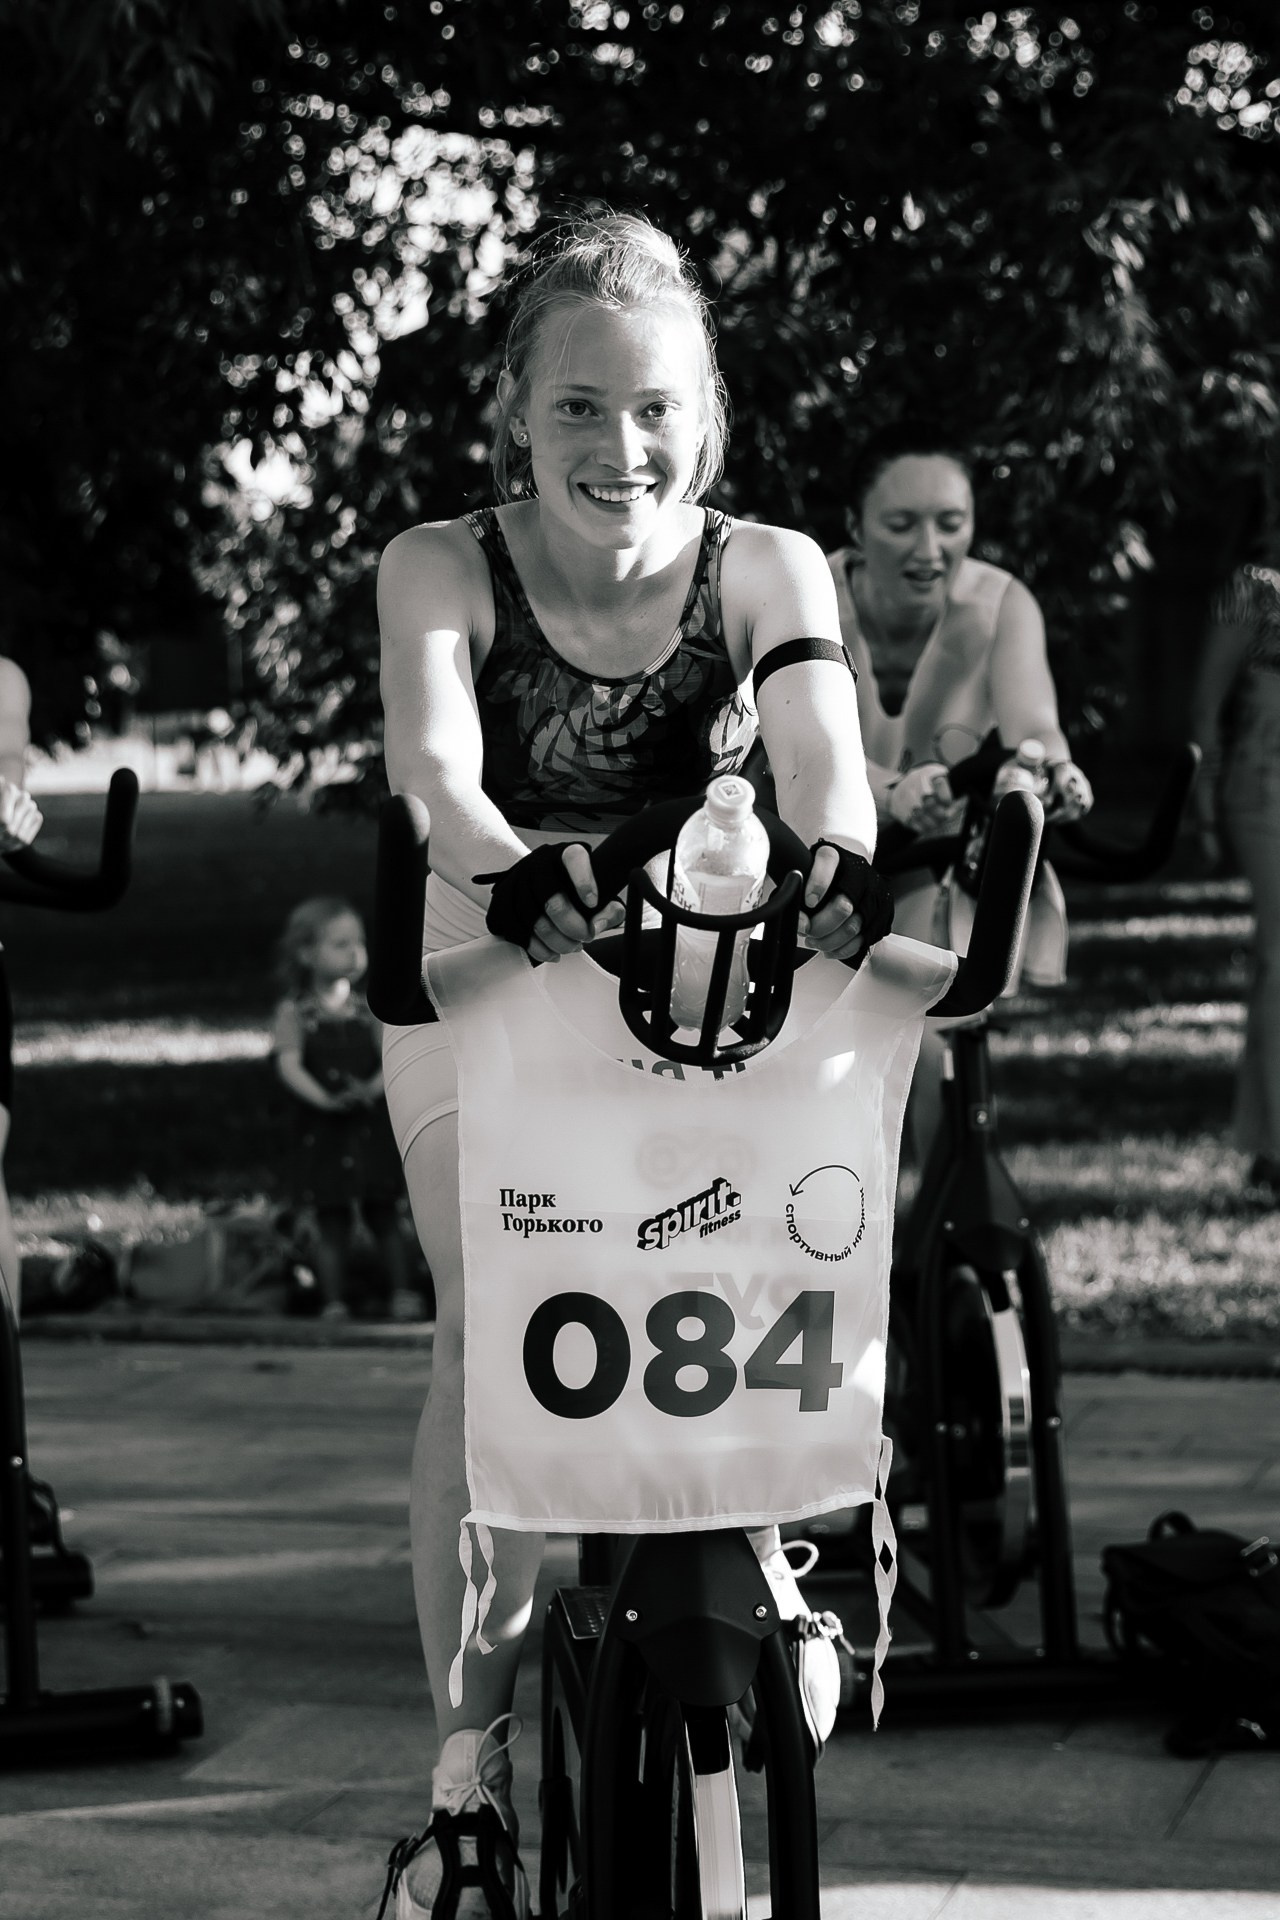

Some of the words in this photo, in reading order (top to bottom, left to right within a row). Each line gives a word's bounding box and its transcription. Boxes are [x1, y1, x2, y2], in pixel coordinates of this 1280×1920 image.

[499, 1188, 556, 1214] Парк
[501, 1213, 604, 1239] Горького
[699, 1209, 742, 1239] fitness
[522, 1290, 844, 1420] 084
